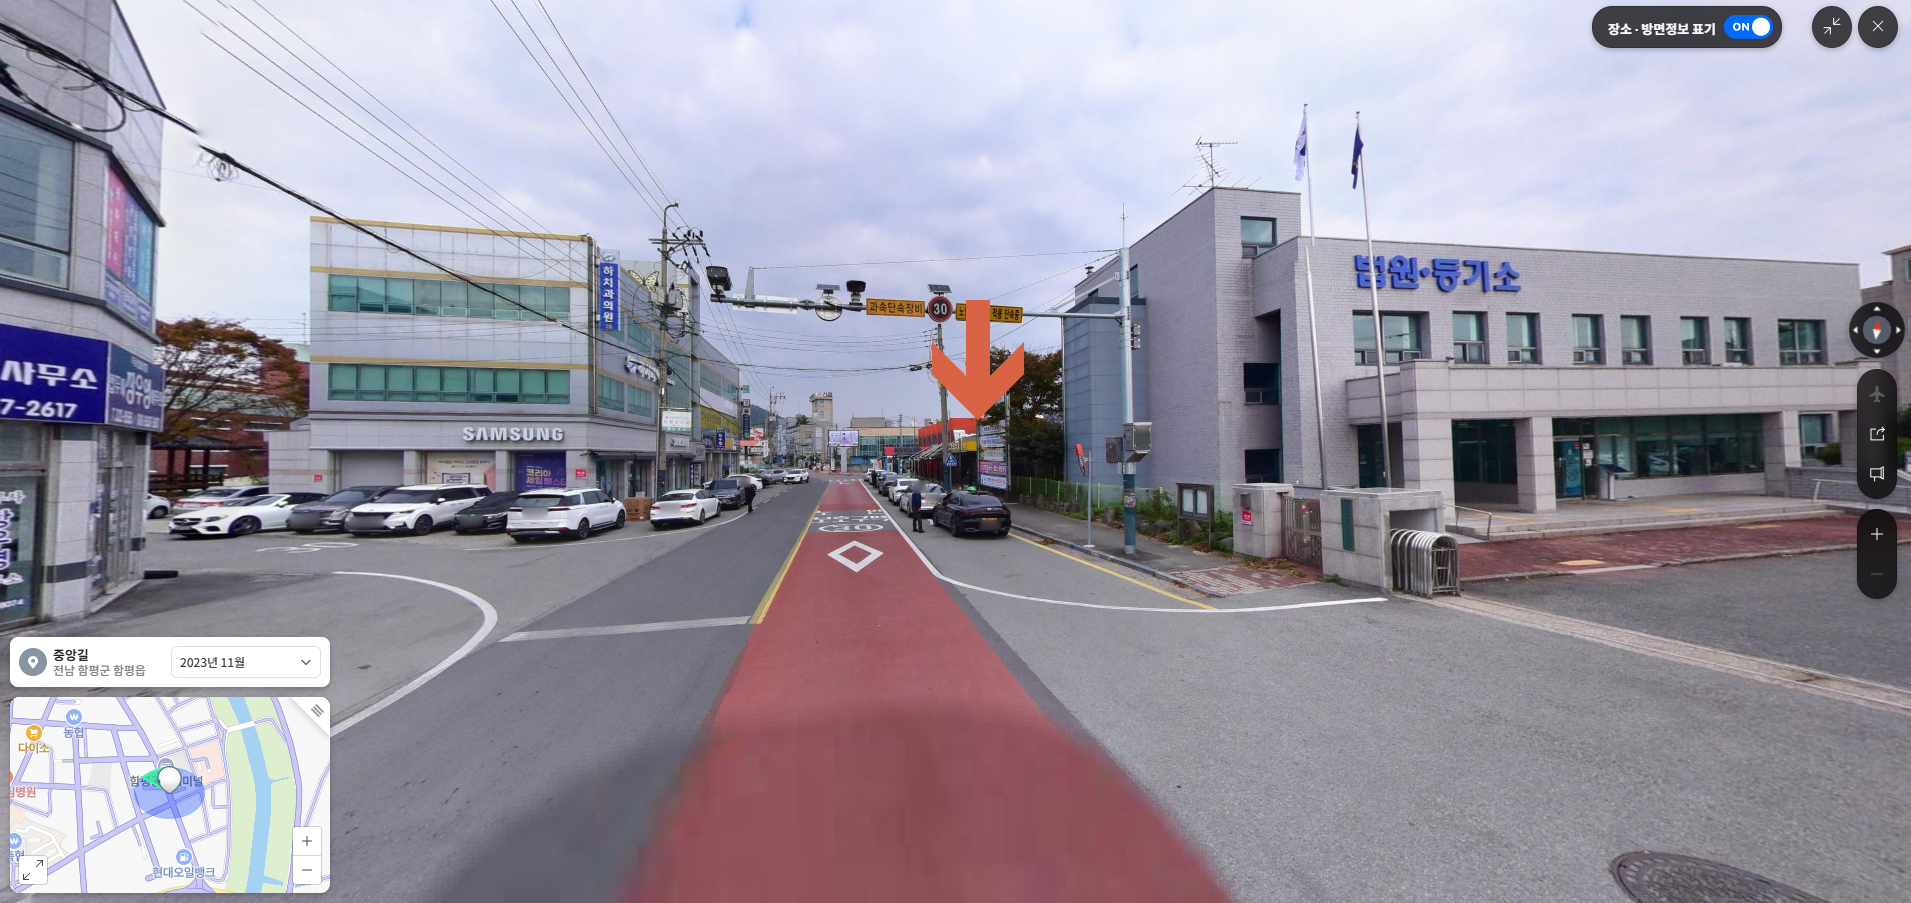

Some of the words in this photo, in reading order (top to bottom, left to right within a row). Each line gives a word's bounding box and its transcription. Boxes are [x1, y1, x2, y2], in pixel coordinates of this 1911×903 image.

[1355, 254, 1522, 293] 법원·등기소
[869, 301, 923, 315] 과속단속장비
[933, 302, 948, 315] 30
[1004, 308, 1020, 321] 단속중
[0, 359, 99, 390] 사무소
[0, 398, 78, 419] 7-2617
[462, 426, 565, 441] SAMSUNG
[526, 468, 552, 478] 코리아
